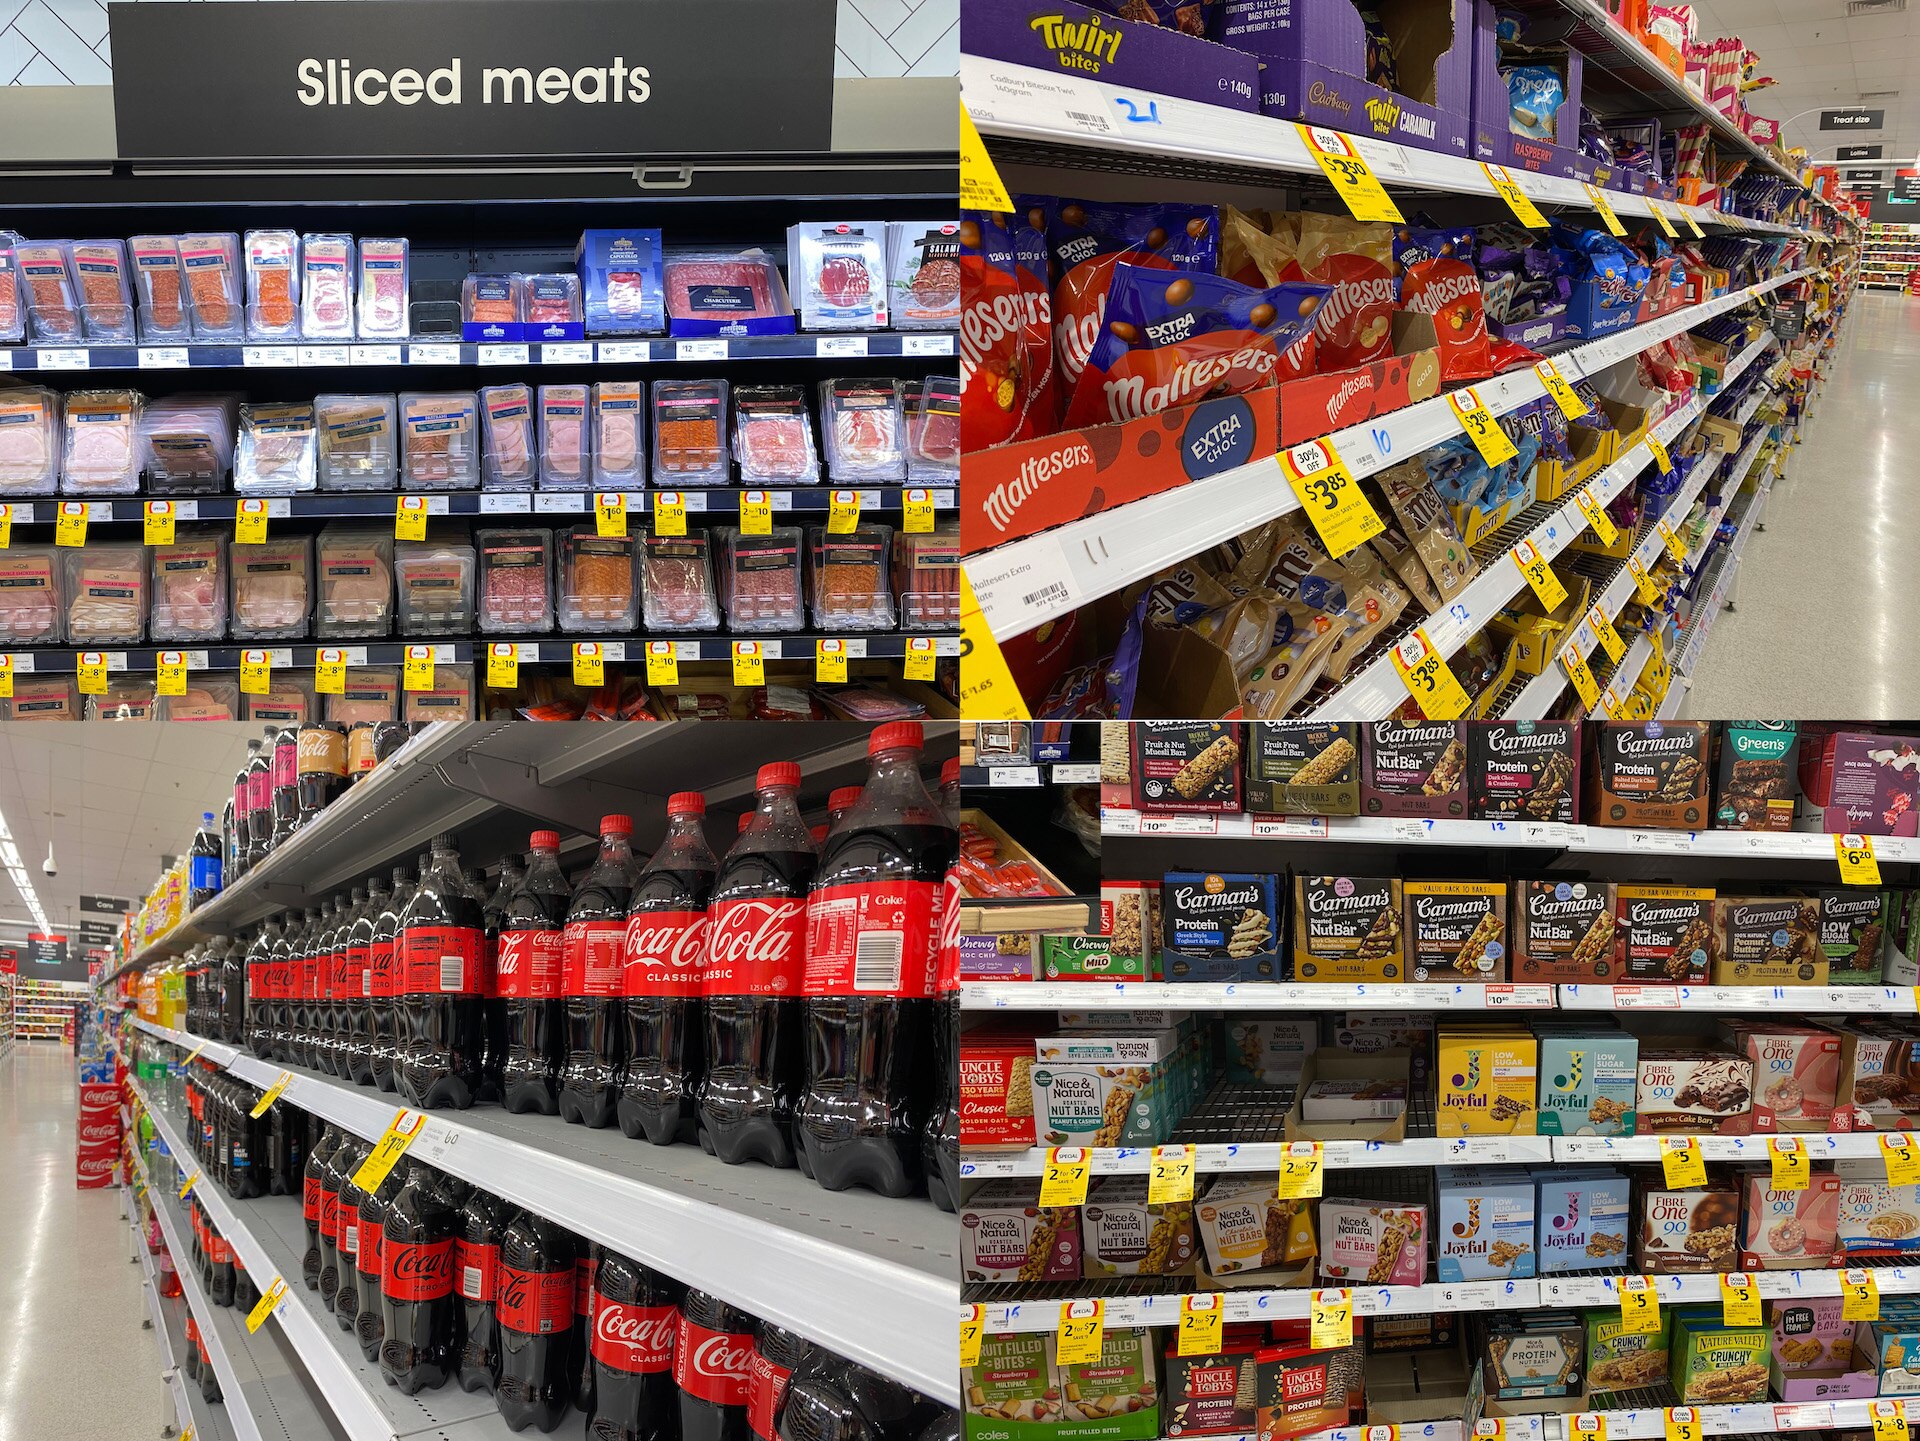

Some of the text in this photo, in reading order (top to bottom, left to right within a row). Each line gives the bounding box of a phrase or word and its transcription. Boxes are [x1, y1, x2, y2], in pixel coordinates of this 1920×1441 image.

[1247, 6, 1291, 21] BAGS PER CASE
[1225, 19, 1291, 36] GROSS WEIGHT: 2.10kg
[1030, 15, 1123, 64] Twirl
[1059, 51, 1101, 74] bites
[297, 56, 651, 106] Sliced meats
[990, 73, 1075, 96] Cadbury Bitesize Twirl
[994, 85, 1032, 99] 140gram
[1230, 79, 1252, 98] 140g
[1262, 92, 1286, 107] 130g
[1308, 80, 1351, 117] Cadbury
[1364, 97, 1401, 128] Twirl
[1833, 115, 1870, 124] Treat size
[1373, 121, 1390, 135] bites
[1400, 111, 1436, 140] CARAMILK
[1318, 134, 1339, 148] 30%
[1514, 142, 1553, 163] RASPBERRY
[1525, 159, 1540, 171] BITES
[1057, 235, 1098, 259] EXTRA
[1070, 249, 1097, 266] CHOC
[1145, 312, 1195, 340] EXTRA
[1159, 328, 1191, 345] CHOC
[1415, 363, 1433, 387] GOLD
[1104, 346, 1278, 422] Maltesers
[1327, 373, 1372, 424] Maltesers
[1191, 413, 1241, 460] EXTRA
[1372, 428, 1392, 456] 10
[1206, 434, 1238, 465] CHOC
[1296, 448, 1320, 465] 30%
[1306, 460, 1321, 472] OFF
[982, 444, 1090, 532] Maltesers
[658, 508, 664, 517] 2
[670, 508, 683, 517] $10
[1010, 563, 1031, 578] Extra
[736, 658, 742, 667] 2
[747, 658, 760, 667] $10
[1374, 721, 1456, 745] Carman's
[1487, 728, 1567, 752] Carman's
[1144, 740, 1186, 750] Fruit & Nut
[1737, 736, 1786, 751] Green's
[1144, 748, 1187, 757] Muesli Bars
[1487, 761, 1528, 773] Protein
[1769, 813, 1789, 822] Fudge
[96, 901, 114, 909] Cans
[875, 894, 903, 906] Coke
[1175, 886, 1259, 911] Carman's
[1631, 902, 1700, 924] Carman's
[1174, 919, 1219, 931] Protein
[1821, 922, 1850, 933] LOW
[923, 885, 944, 995] RECYCLE ME
[1821, 932, 1849, 941] SUGAR
[1073, 936, 1110, 953] Chewy
[1086, 957, 1109, 967] MILO
[1766, 1038, 1792, 1048] FIBRE
[1762, 1046, 1793, 1060] One
[960, 1061, 1003, 1072] UNCLE
[1770, 1060, 1792, 1073] 90
[961, 1072, 1004, 1084] TOBYS
[1055, 1078, 1090, 1090] Nice &
[1053, 1088, 1095, 1099] Natural
[1443, 1093, 1488, 1109] Joyful
[963, 1102, 1005, 1115] Classic
[1051, 1105, 1100, 1116] NUT BARS
[1058, 1152, 1079, 1160] SPECIAL
[1674, 1151, 1690, 1163] $5
[1049, 1167, 1084, 1181] 2 for $7
[1005, 1340, 1042, 1355] FILLED
[1699, 1334, 1765, 1350] NATURE VALLEY
[630, 1353, 671, 1363] CLASSIC
[676, 1319, 688, 1386] RECYCLE ME
[1710, 1350, 1752, 1362] CRUNCHY
[994, 1355, 1025, 1370] BITES
[992, 1370, 1029, 1379] Strawberry
[995, 1379, 1028, 1387] MULTIPACK
[1197, 1399, 1233, 1409] PROTEIN
[976, 1430, 1009, 1440] coles
[1057, 1426, 1121, 1437] FRUIT FILLED BITES
